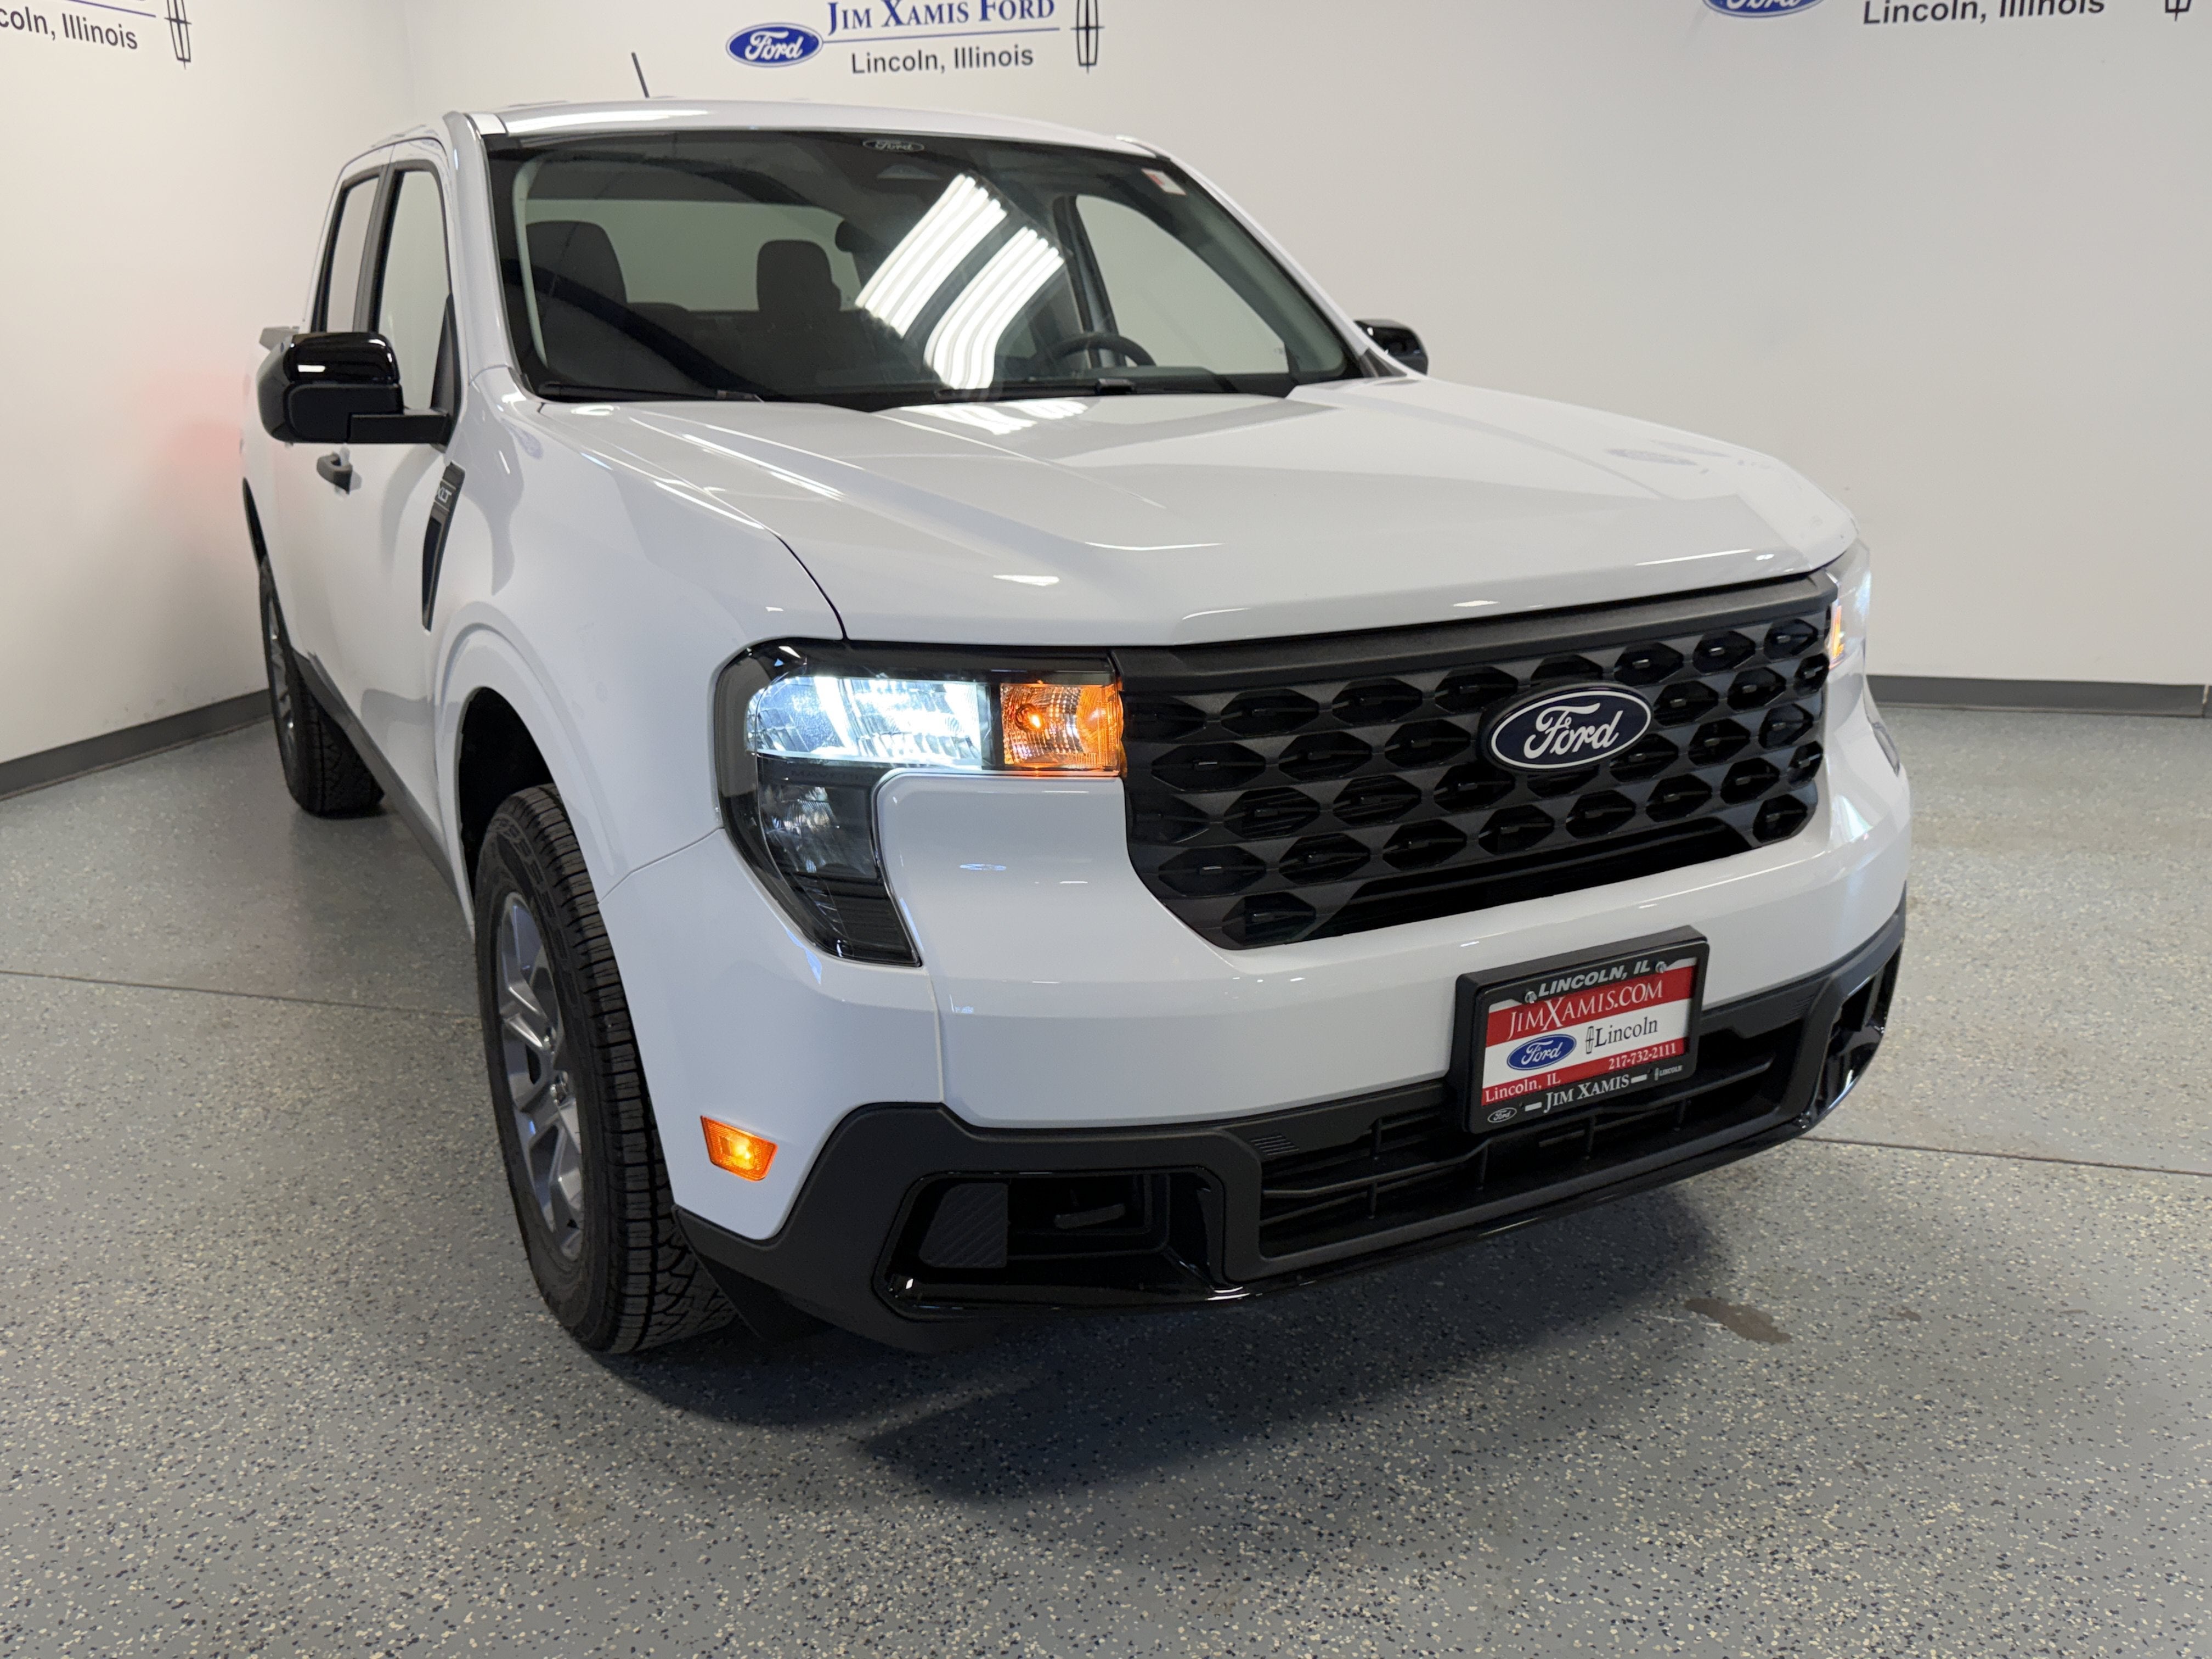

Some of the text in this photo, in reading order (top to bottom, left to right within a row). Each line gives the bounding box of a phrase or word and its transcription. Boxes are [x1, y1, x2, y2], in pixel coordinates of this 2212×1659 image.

[827, 0, 1054, 36] JIM XAMIS FORD
[1863, 0, 2105, 24] Lincoln, Illinois
[61, 13, 138, 49] Illinois
[744, 31, 804, 61] Ford
[851, 44, 1034, 74] Lincoln, Illinois
[874, 139, 913, 150] Ford
[1523, 702, 1624, 759] Ford
[1538, 960, 1651, 998] LINCOLN, IL
[1506, 979, 1663, 1041] JIMXAMIS.COM
[1594, 1016, 1658, 1048] Lincoln
[1520, 1040, 1564, 1065] Ford
[1608, 1042, 1677, 1070] 217-732-2111
[1485, 1072, 1561, 1103] Lincoln, IL
[1543, 1074, 1630, 1114] JIM XAMIS
[1493, 1109, 1511, 1121] Ford
